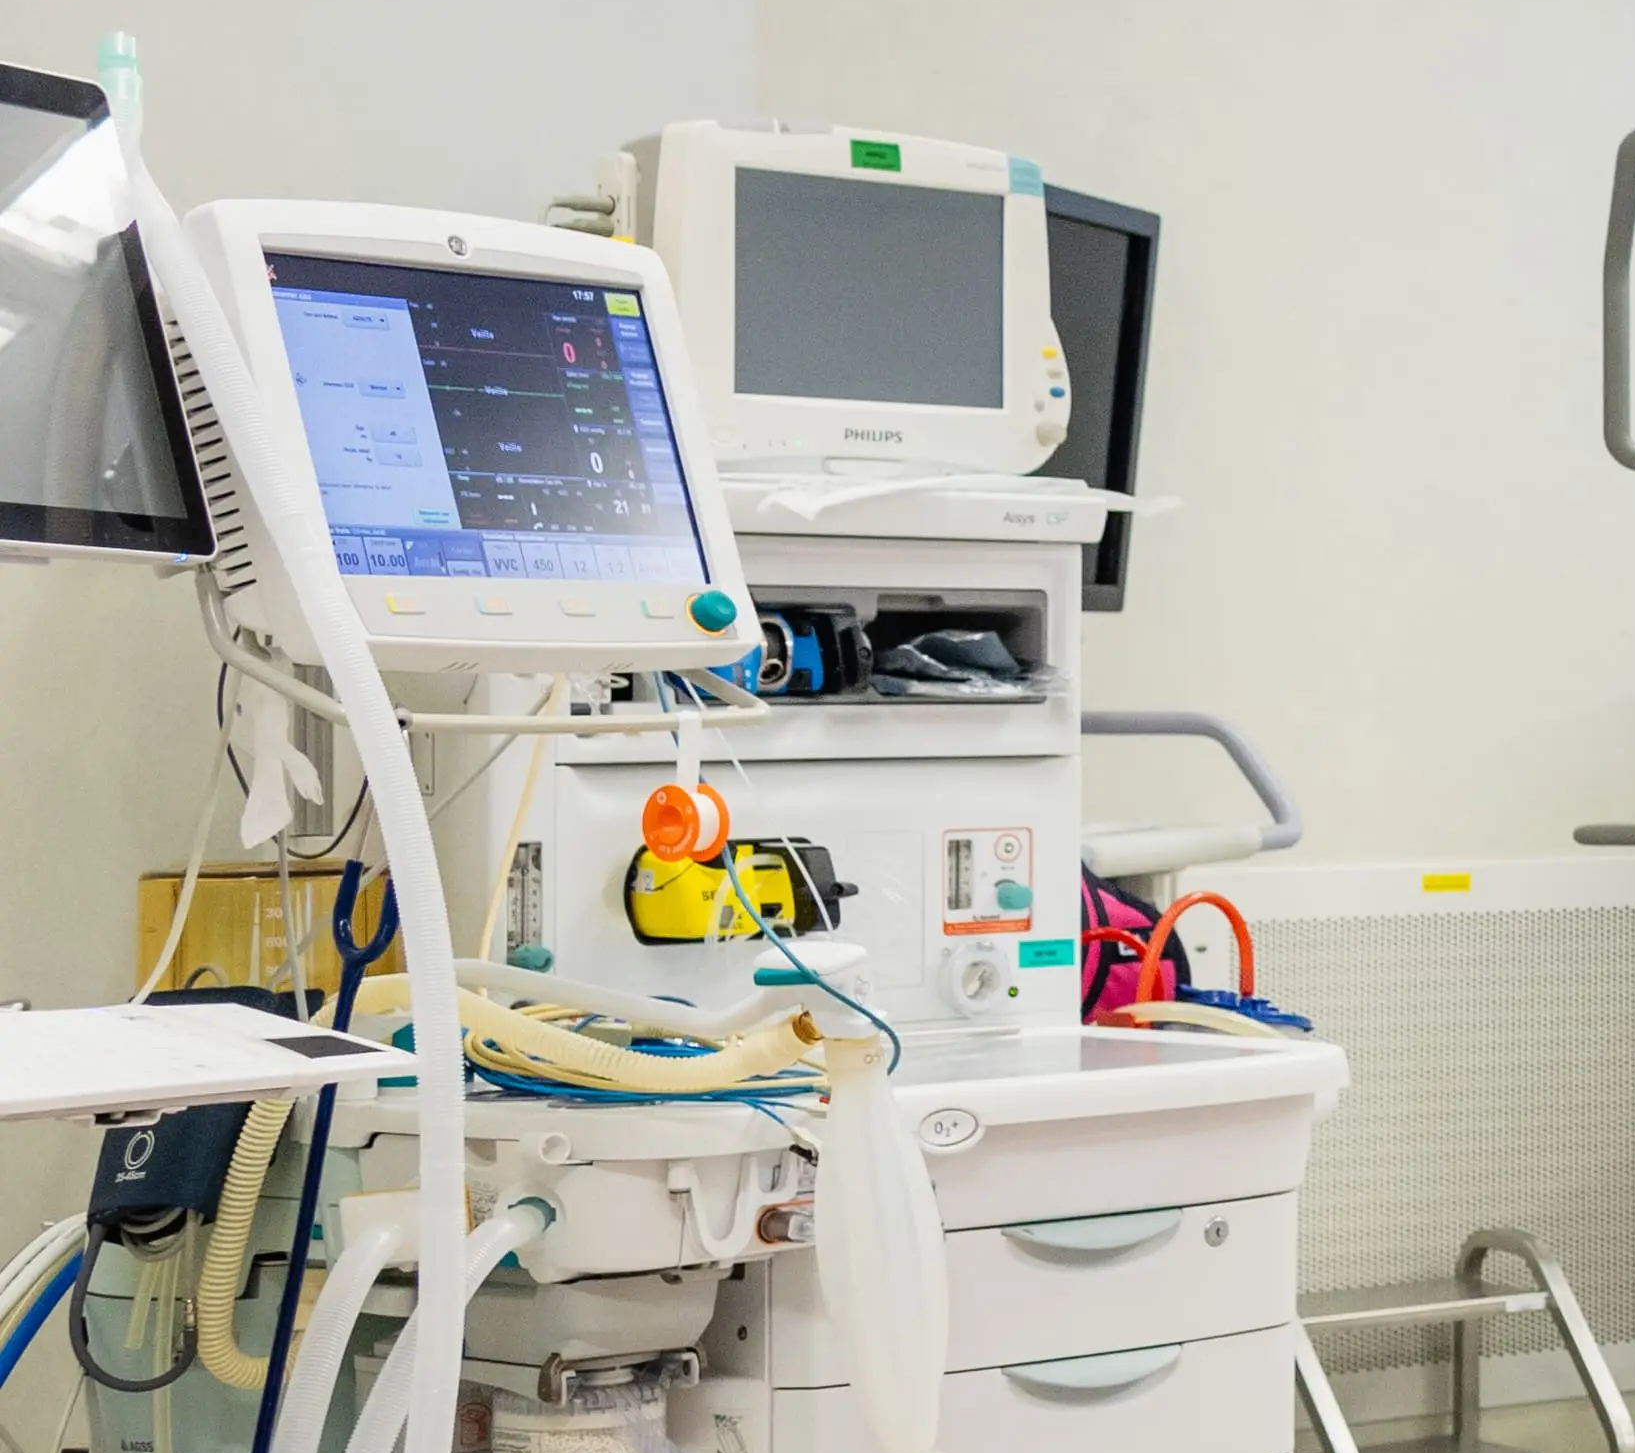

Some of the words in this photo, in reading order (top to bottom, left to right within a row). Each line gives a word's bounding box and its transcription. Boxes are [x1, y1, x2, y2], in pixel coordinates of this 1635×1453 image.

[563, 342, 576, 363] 0
[844, 427, 903, 444] PHILIPS
[590, 452, 603, 474] 0
[370, 554, 406, 568] 10.00
